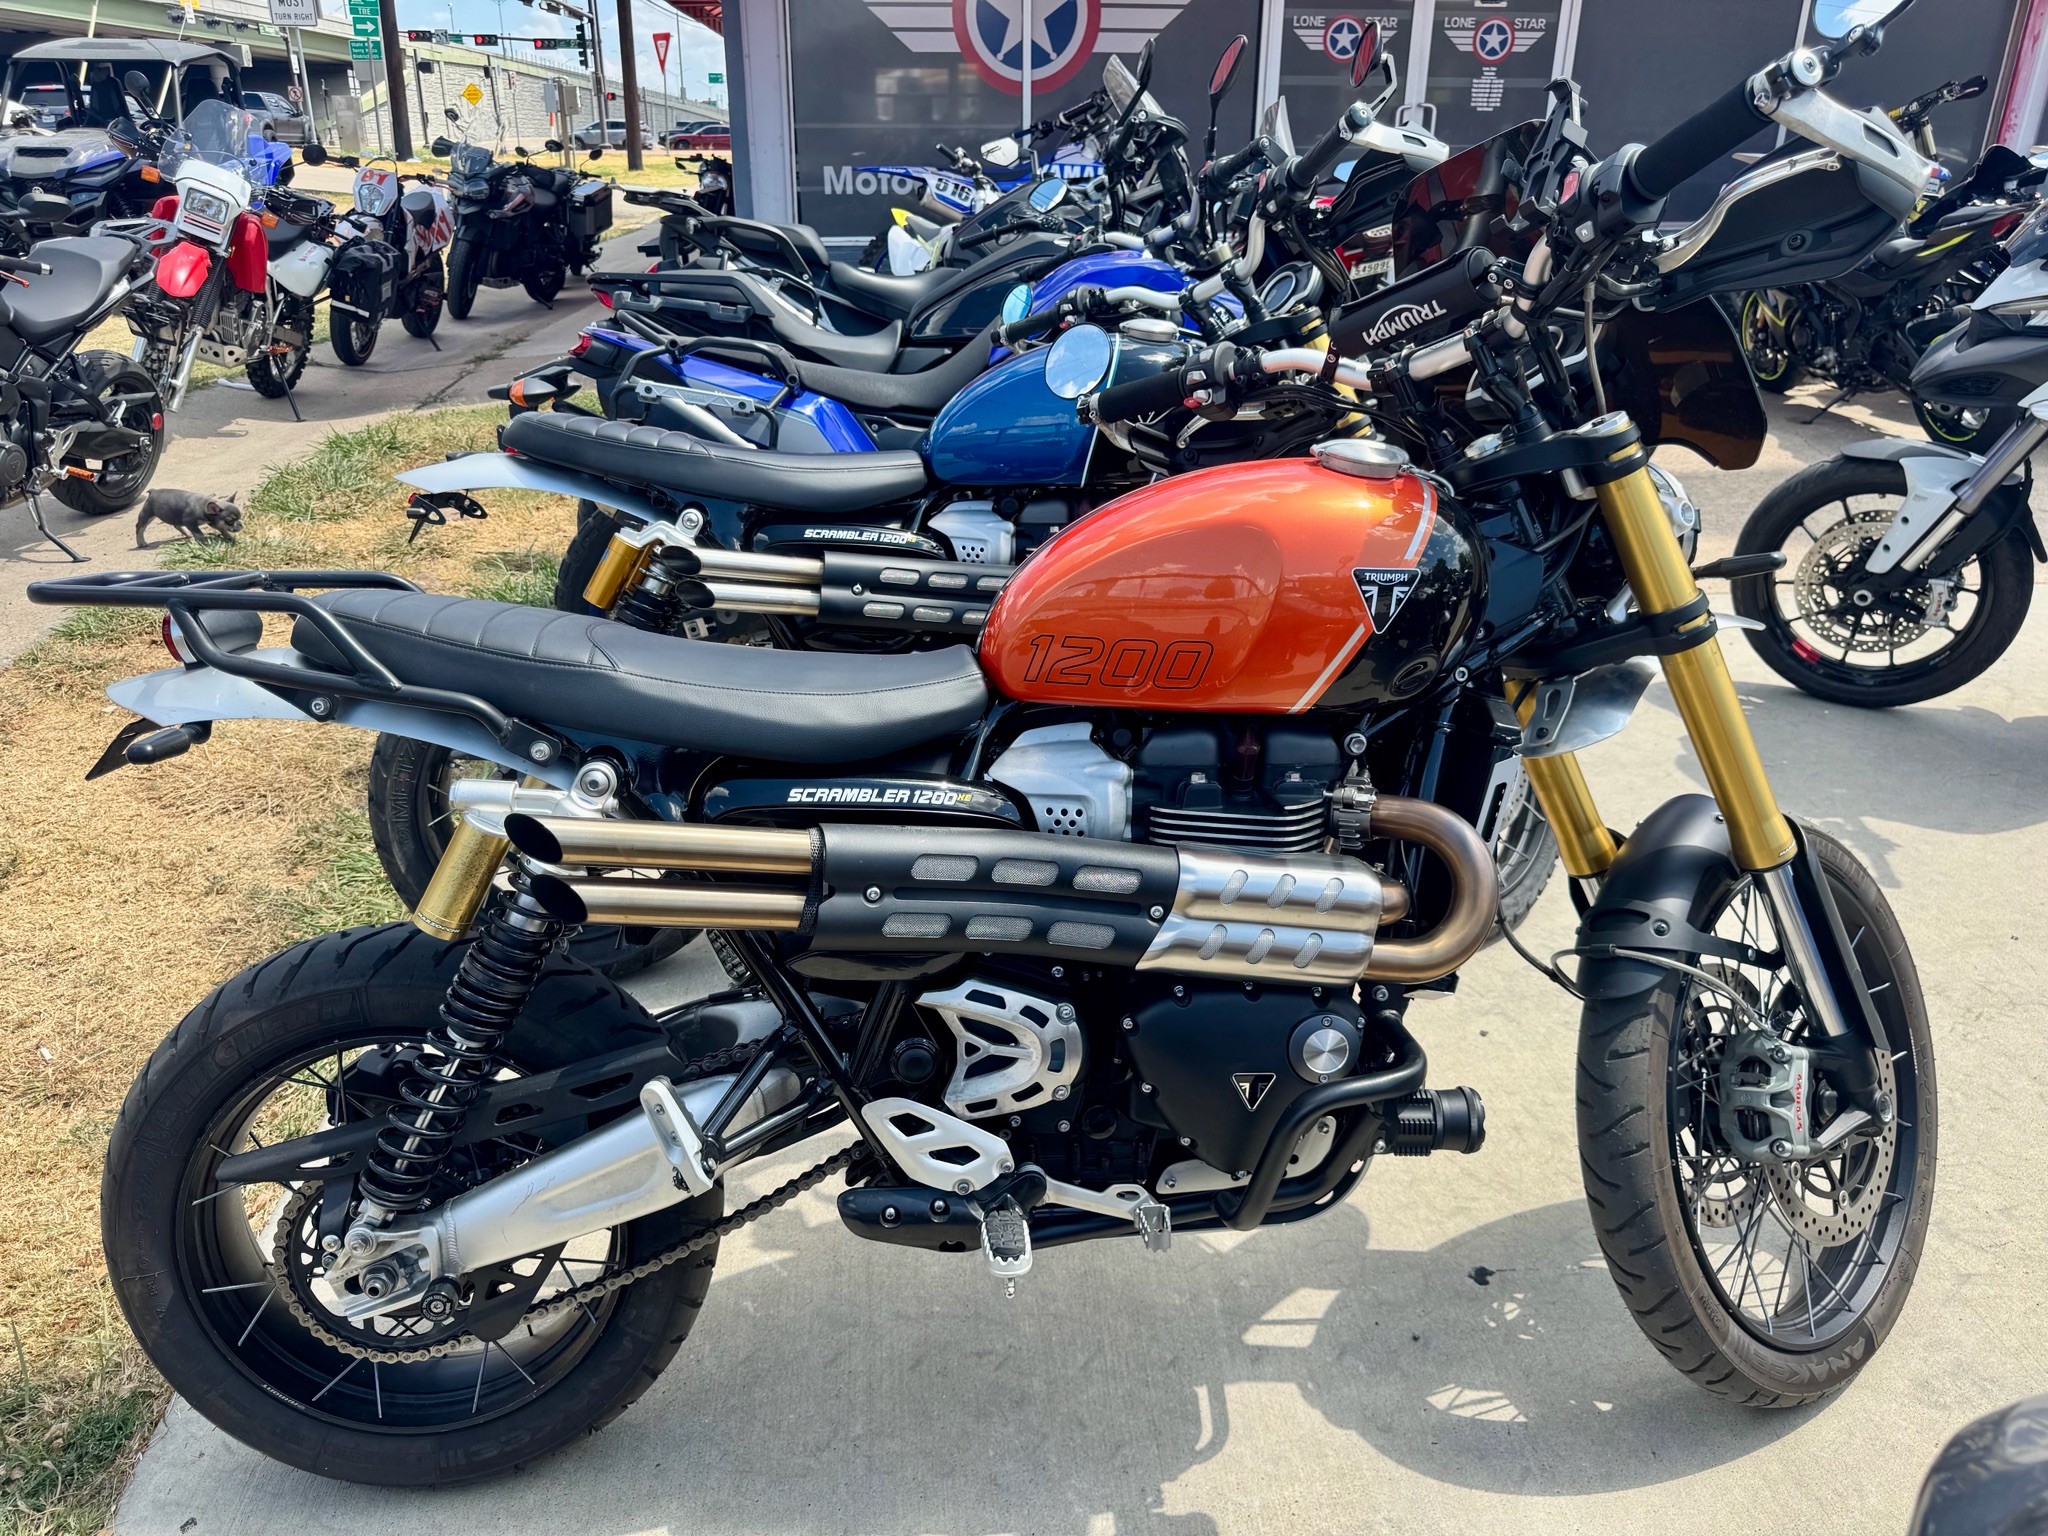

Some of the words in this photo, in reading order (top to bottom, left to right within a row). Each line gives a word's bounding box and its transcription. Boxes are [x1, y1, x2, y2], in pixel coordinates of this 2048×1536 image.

[294, 13, 313, 21] RIGHT
[1293, 15, 1326, 27] LONE
[1364, 17, 1398, 29] STAR
[1444, 17, 1476, 29] LONE
[1514, 18, 1546, 30] STAR
[1362, 300, 1447, 346] TRIUMPH
[803, 528, 879, 542] SCRAMBLER
[1364, 572, 1408, 582] TRIUMPH
[1023, 634, 1214, 690] 1200
[787, 788, 909, 803] SCRAMBLER
